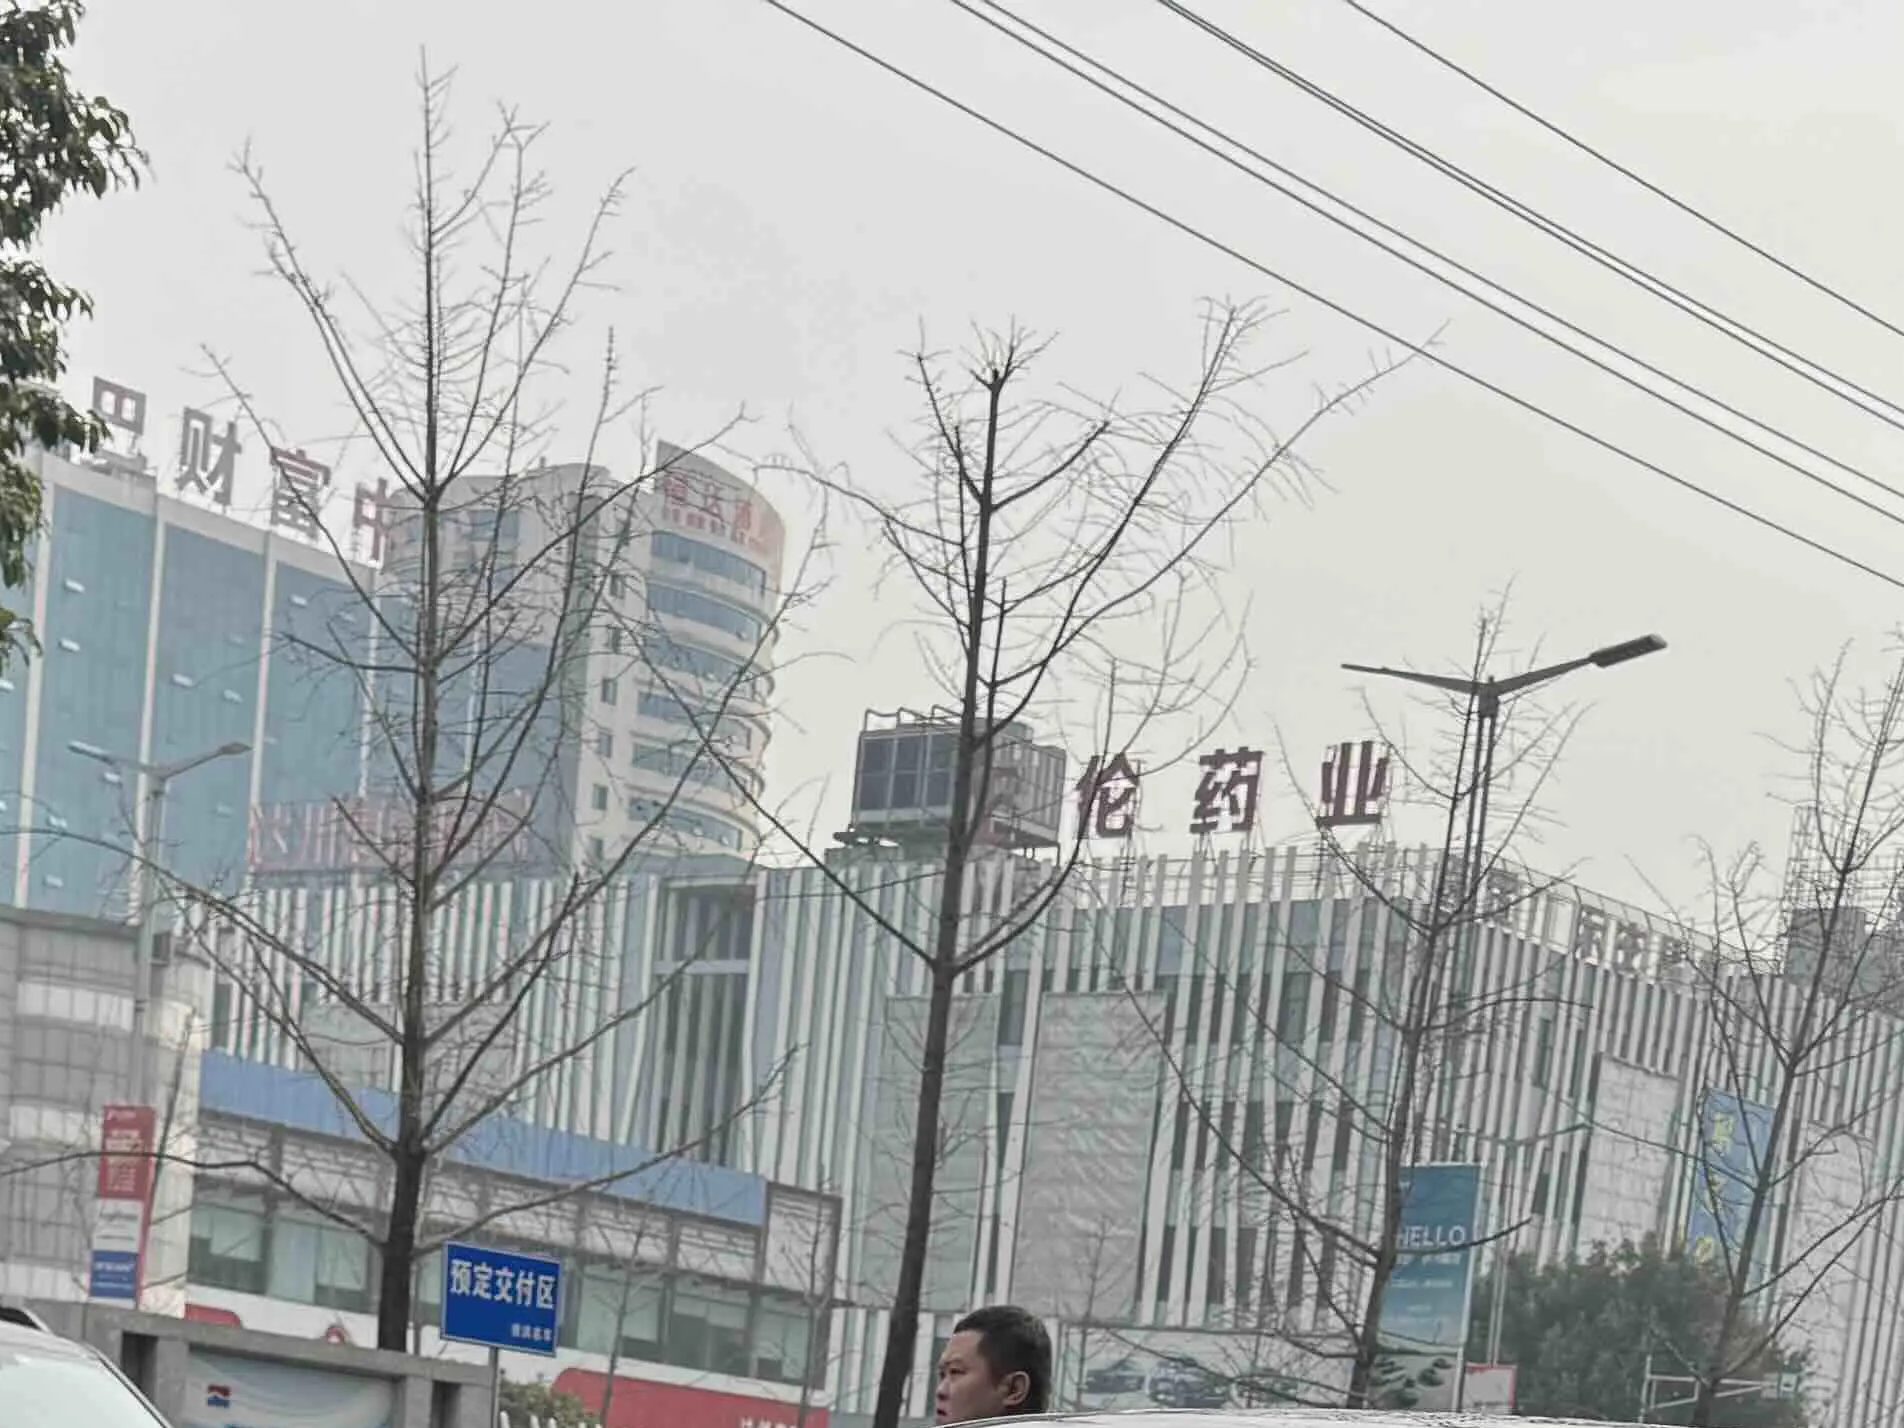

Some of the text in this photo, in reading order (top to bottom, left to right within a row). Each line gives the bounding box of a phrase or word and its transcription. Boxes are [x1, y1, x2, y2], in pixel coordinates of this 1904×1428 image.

[1396, 1224, 1467, 1249] HELLO
[450, 1258, 555, 1309] 预定交付区
